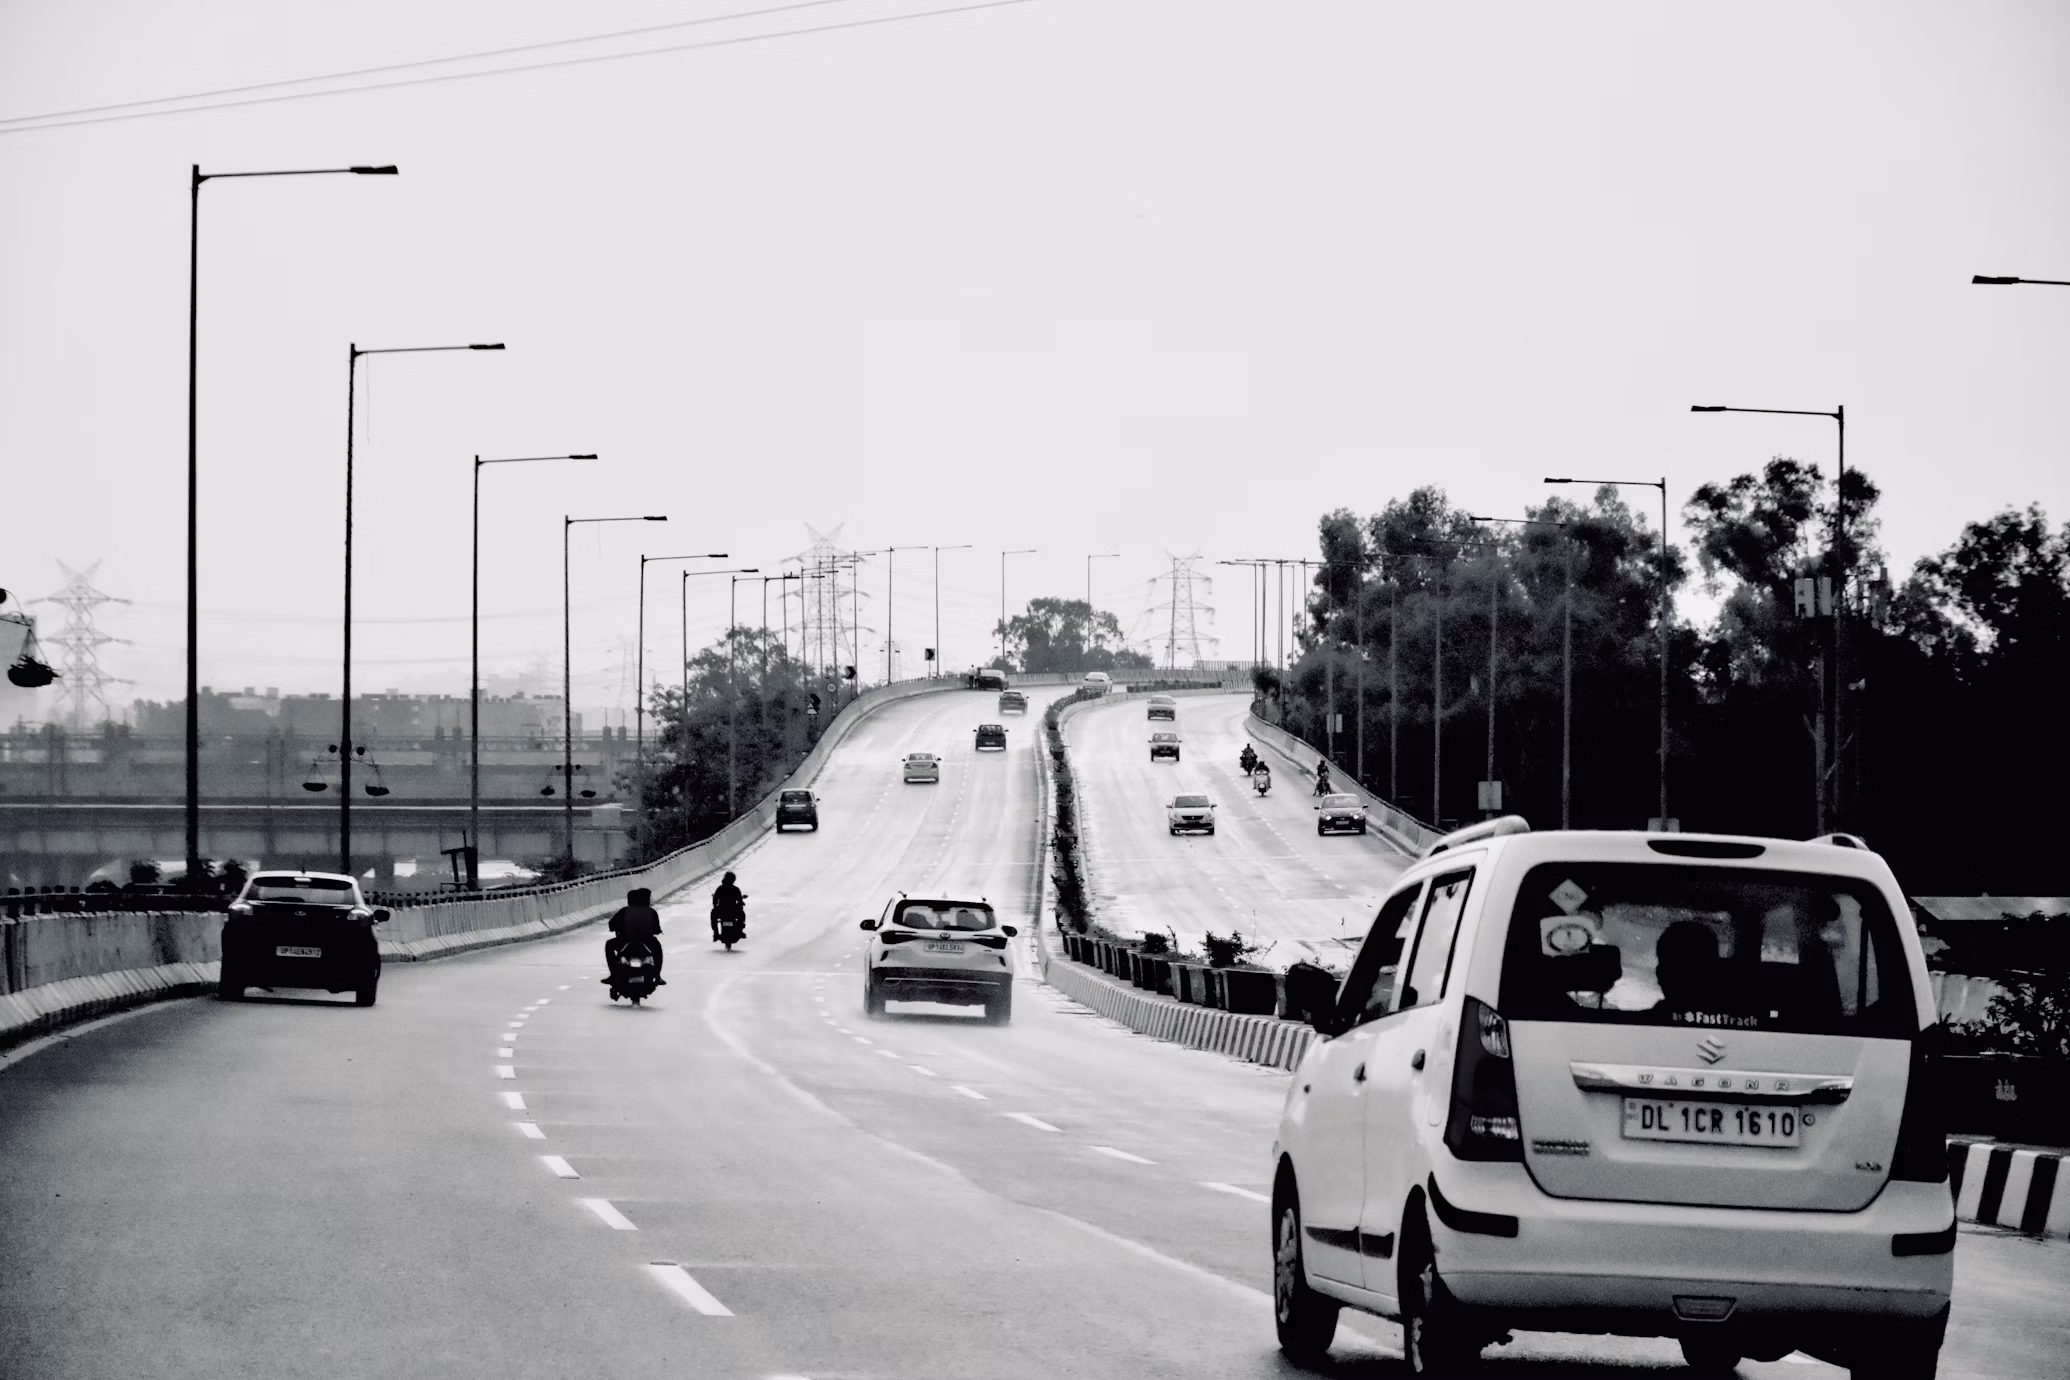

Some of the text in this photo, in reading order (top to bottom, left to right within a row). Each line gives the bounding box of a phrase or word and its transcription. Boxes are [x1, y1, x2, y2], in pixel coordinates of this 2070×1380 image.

[1641, 1105, 1795, 1137] DL 1CR 1610
